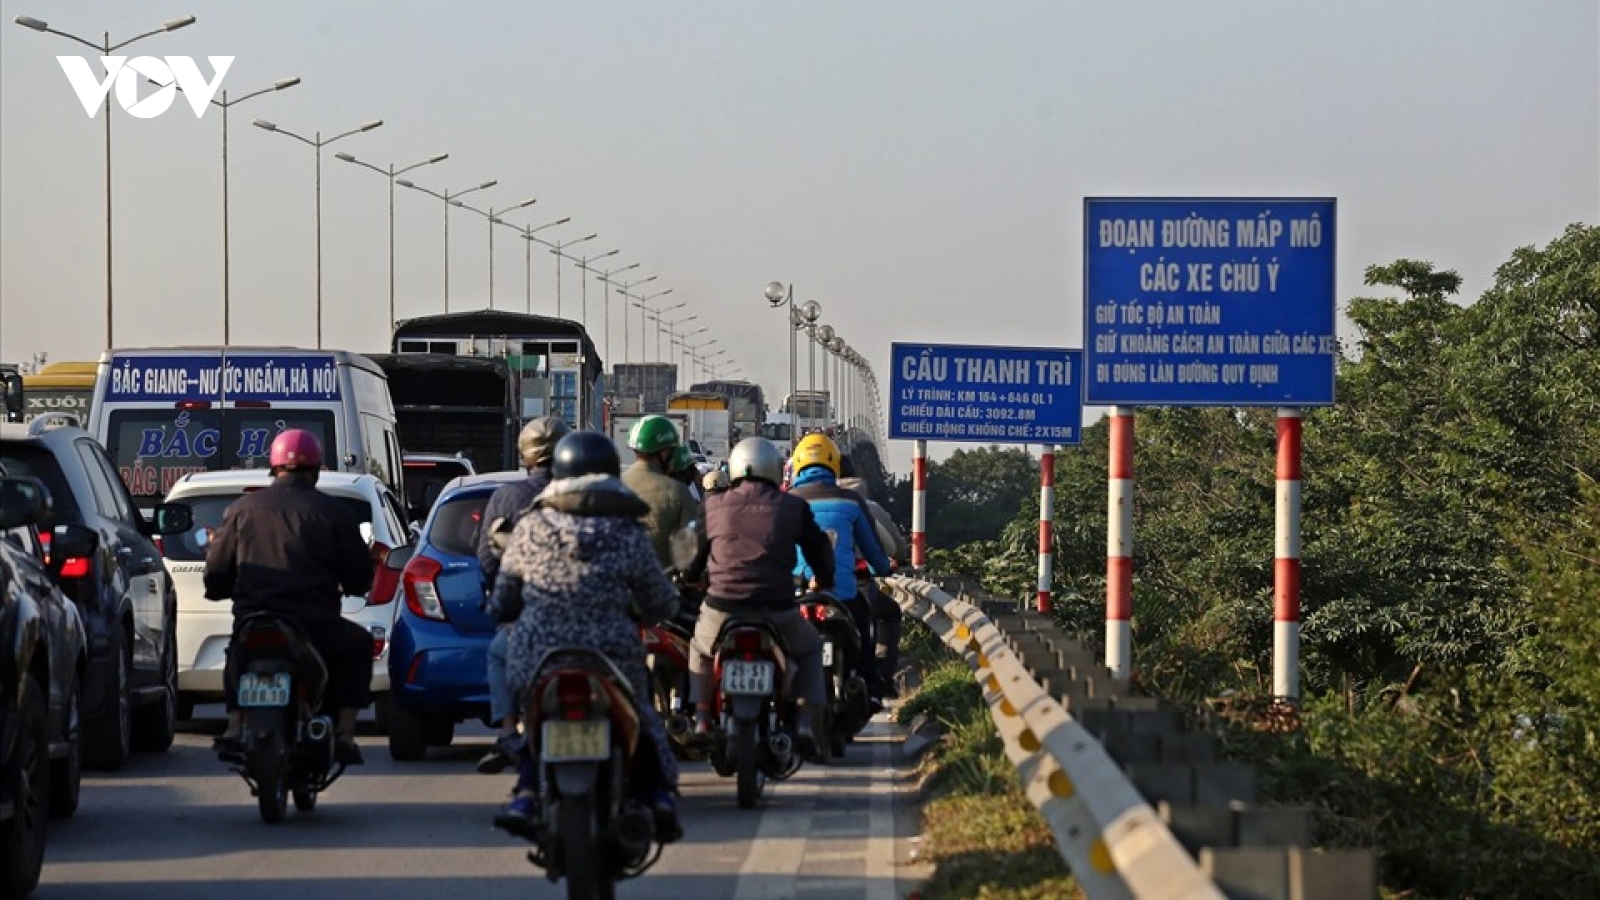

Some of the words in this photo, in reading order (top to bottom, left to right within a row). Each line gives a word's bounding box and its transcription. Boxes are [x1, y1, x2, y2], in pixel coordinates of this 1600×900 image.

[1099, 219, 1154, 254] ĐOẠN
[1161, 212, 1230, 247] ĐƯỜNG
[1236, 210, 1283, 247] MẤP
[1289, 212, 1322, 247] MÔ
[1140, 256, 1180, 292] CÁC
[1186, 263, 1213, 292] XE
[1219, 256, 1260, 292] CHÚ
[1266, 256, 1280, 292] Ý
[1095, 300, 1117, 324] GIỮ
[1121, 299, 1143, 324] TỐC
[1147, 301, 1164, 329] ĐỘ
[1167, 305, 1184, 324] AN
[1188, 301, 1221, 324] TOÀN
[1095, 330, 1117, 354] GIỮ
[1120, 327, 1169, 354] KHOẢNG
[1172, 330, 1204, 354] CÁCH
[1207, 335, 1224, 354] AN
[1228, 331, 1260, 354] TOÀN
[1262, 330, 1291, 355] GIỮA
[1293, 331, 1316, 355] CÁC
[1318, 335, 1336, 355] XE
[112, 359, 141, 395] BẮC
[312, 363, 338, 399] NỘI
[902, 347, 948, 382] CẦU
[954, 357, 1030, 384] THANH
[1035, 355, 1072, 386] TRÌ
[1096, 364, 1109, 383] ĐI
[1113, 359, 1146, 383] ĐÚNG
[1150, 359, 1174, 383] LÀN
[1177, 359, 1218, 383] ĐƯỜNG
[1222, 364, 1246, 385] QUY
[1249, 364, 1279, 388] ĐỊNH
[28, 395, 86, 408] XUÔI
[917, 387, 955, 401] TRÌNH:
[957, 391, 976, 403] KM
[1032, 393, 1045, 406] QL
[1047, 393, 1053, 405] 1
[985, 408, 1036, 421] 3092.8M
[138, 411, 220, 458] BẮC
[1034, 426, 1072, 438] 2X15M
